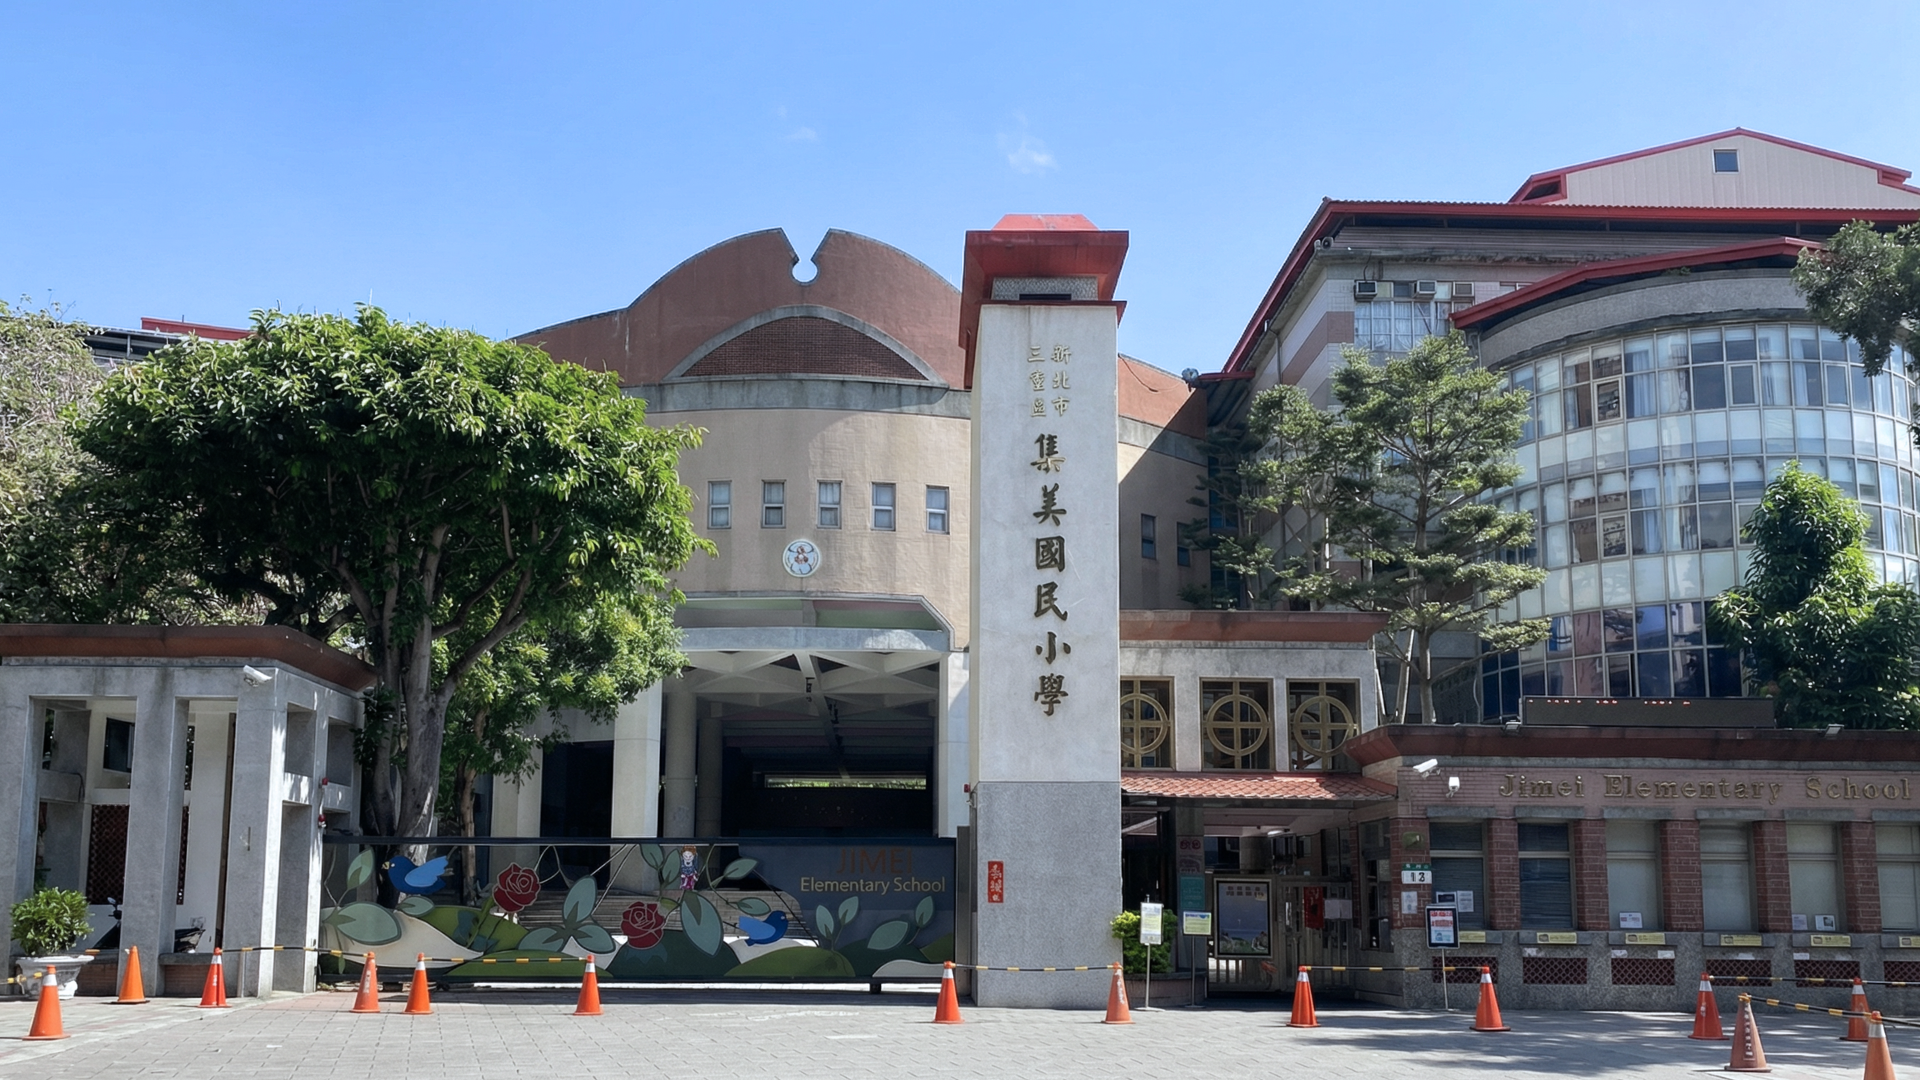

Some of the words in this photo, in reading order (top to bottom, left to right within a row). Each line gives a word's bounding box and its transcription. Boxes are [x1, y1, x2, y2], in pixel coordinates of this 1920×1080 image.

[1027, 345, 1046, 417] 三重區
[1051, 344, 1072, 417] 新北市
[1030, 433, 1071, 716] 集美國民小學
[1500, 774, 1585, 798] Jimei
[1604, 774, 1783, 805] Elementary
[1805, 776, 1911, 800] School
[800, 877, 890, 895] Elementary
[893, 876, 946, 893] School
[836, 848, 913, 874] JIMEI
